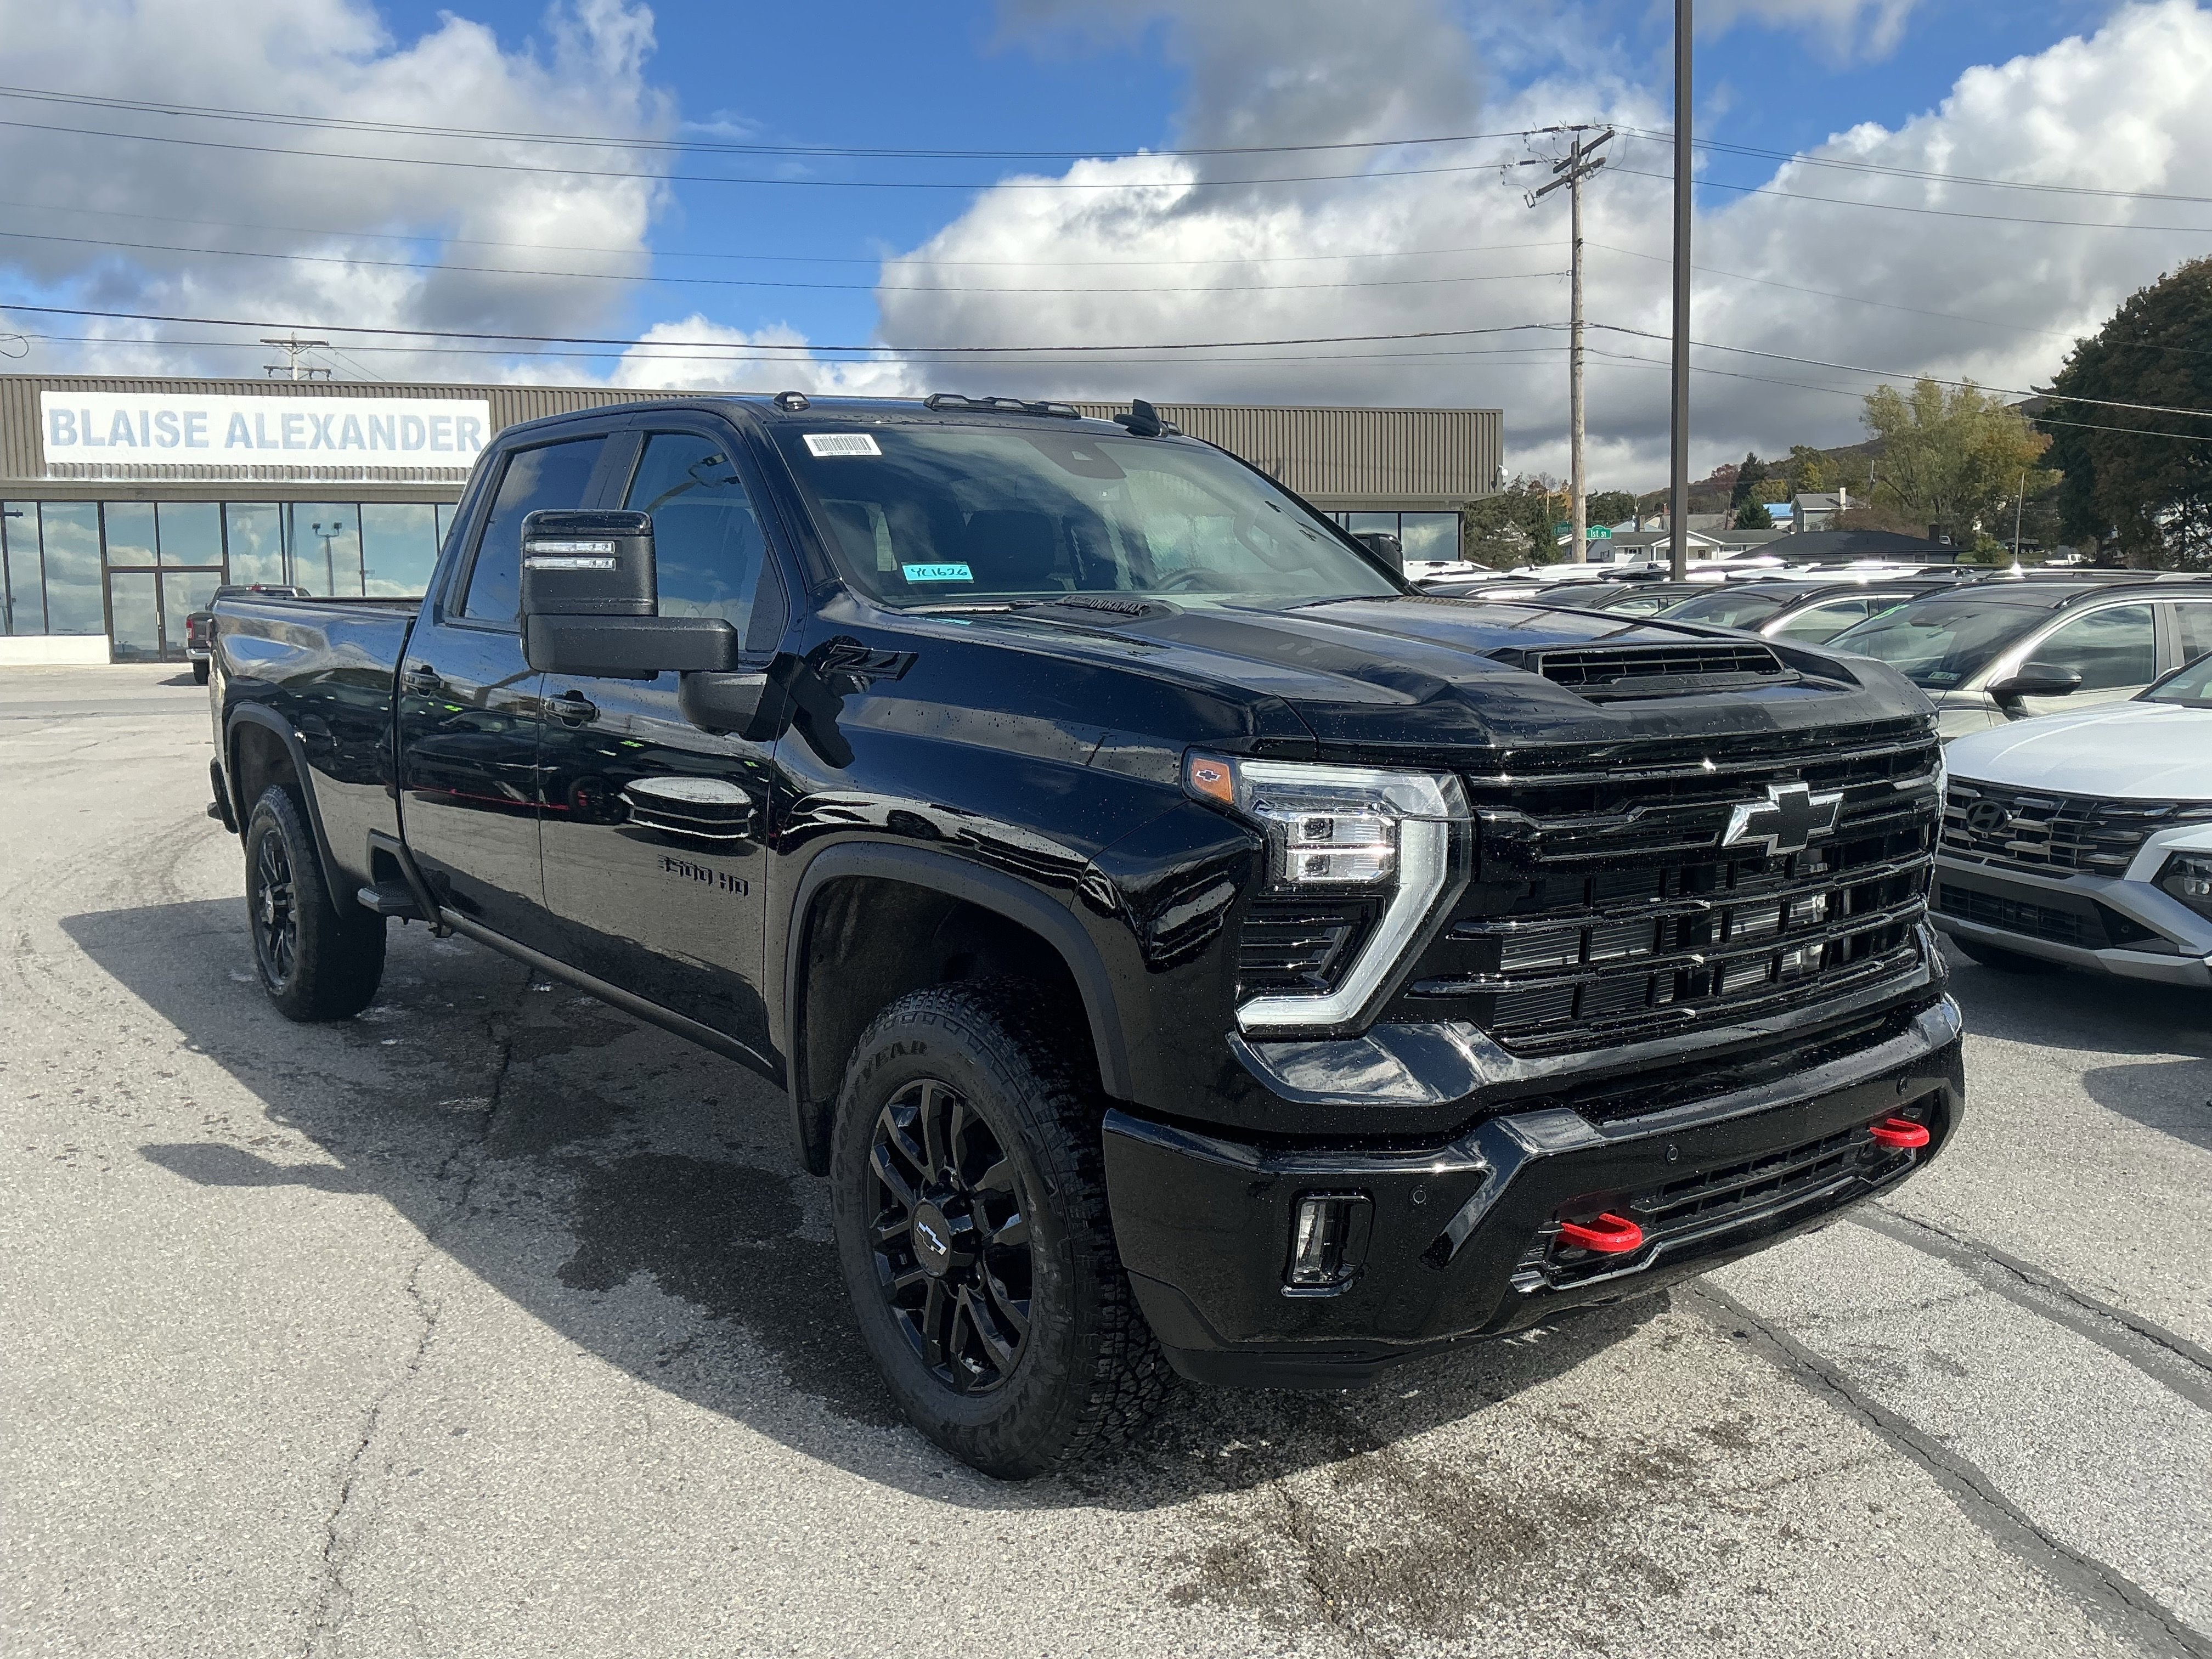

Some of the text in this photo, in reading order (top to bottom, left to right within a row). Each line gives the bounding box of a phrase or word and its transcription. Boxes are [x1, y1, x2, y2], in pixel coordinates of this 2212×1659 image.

[49, 409, 483, 452] BLAISE ALEXANDER
[1089, 599, 1150, 617] DURAMAX
[719, 872, 749, 896] HD
